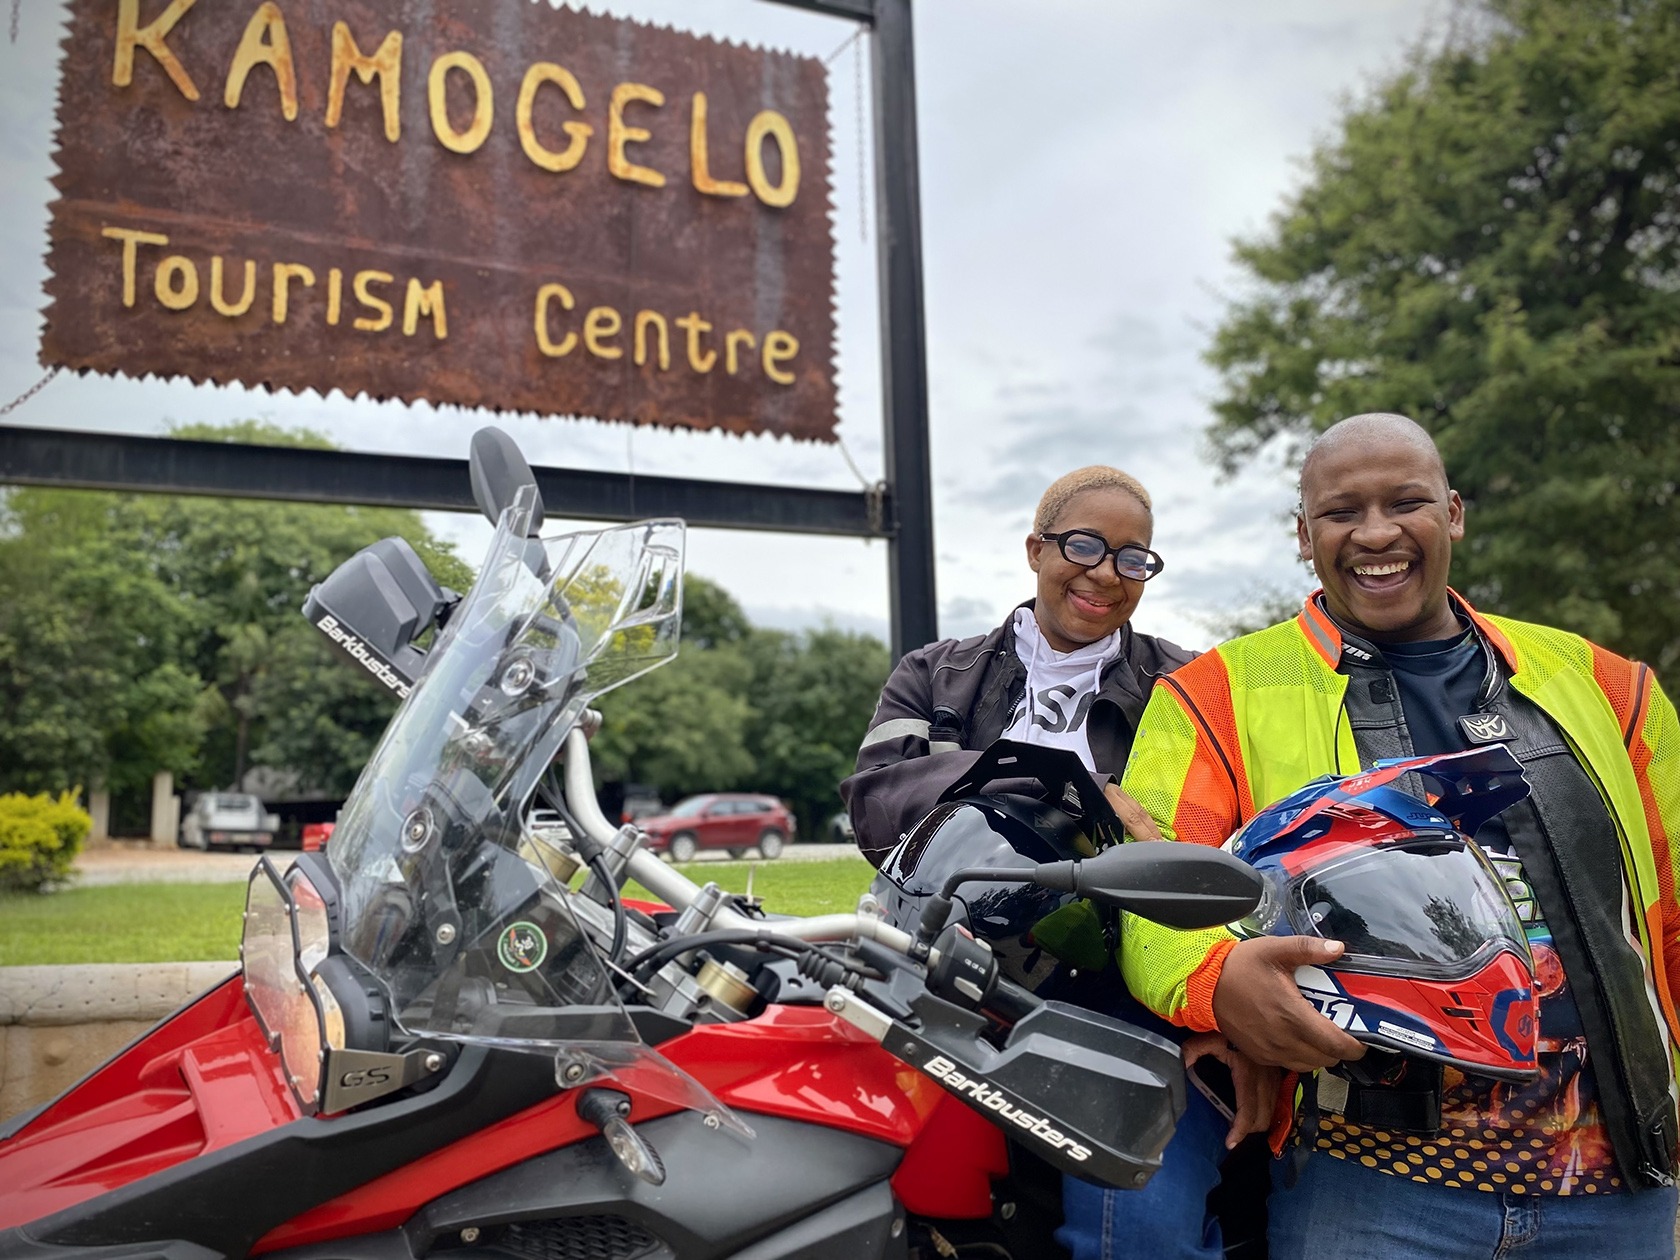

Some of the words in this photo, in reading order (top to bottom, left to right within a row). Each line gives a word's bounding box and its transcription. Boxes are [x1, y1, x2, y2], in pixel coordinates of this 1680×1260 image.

[112, 0, 800, 208] KAMOGELO
[534, 283, 799, 385] Centre
[316, 615, 412, 699] Barkbusters
[340, 1066, 392, 1087] GS
[923, 1055, 1092, 1161] Barkbusters
